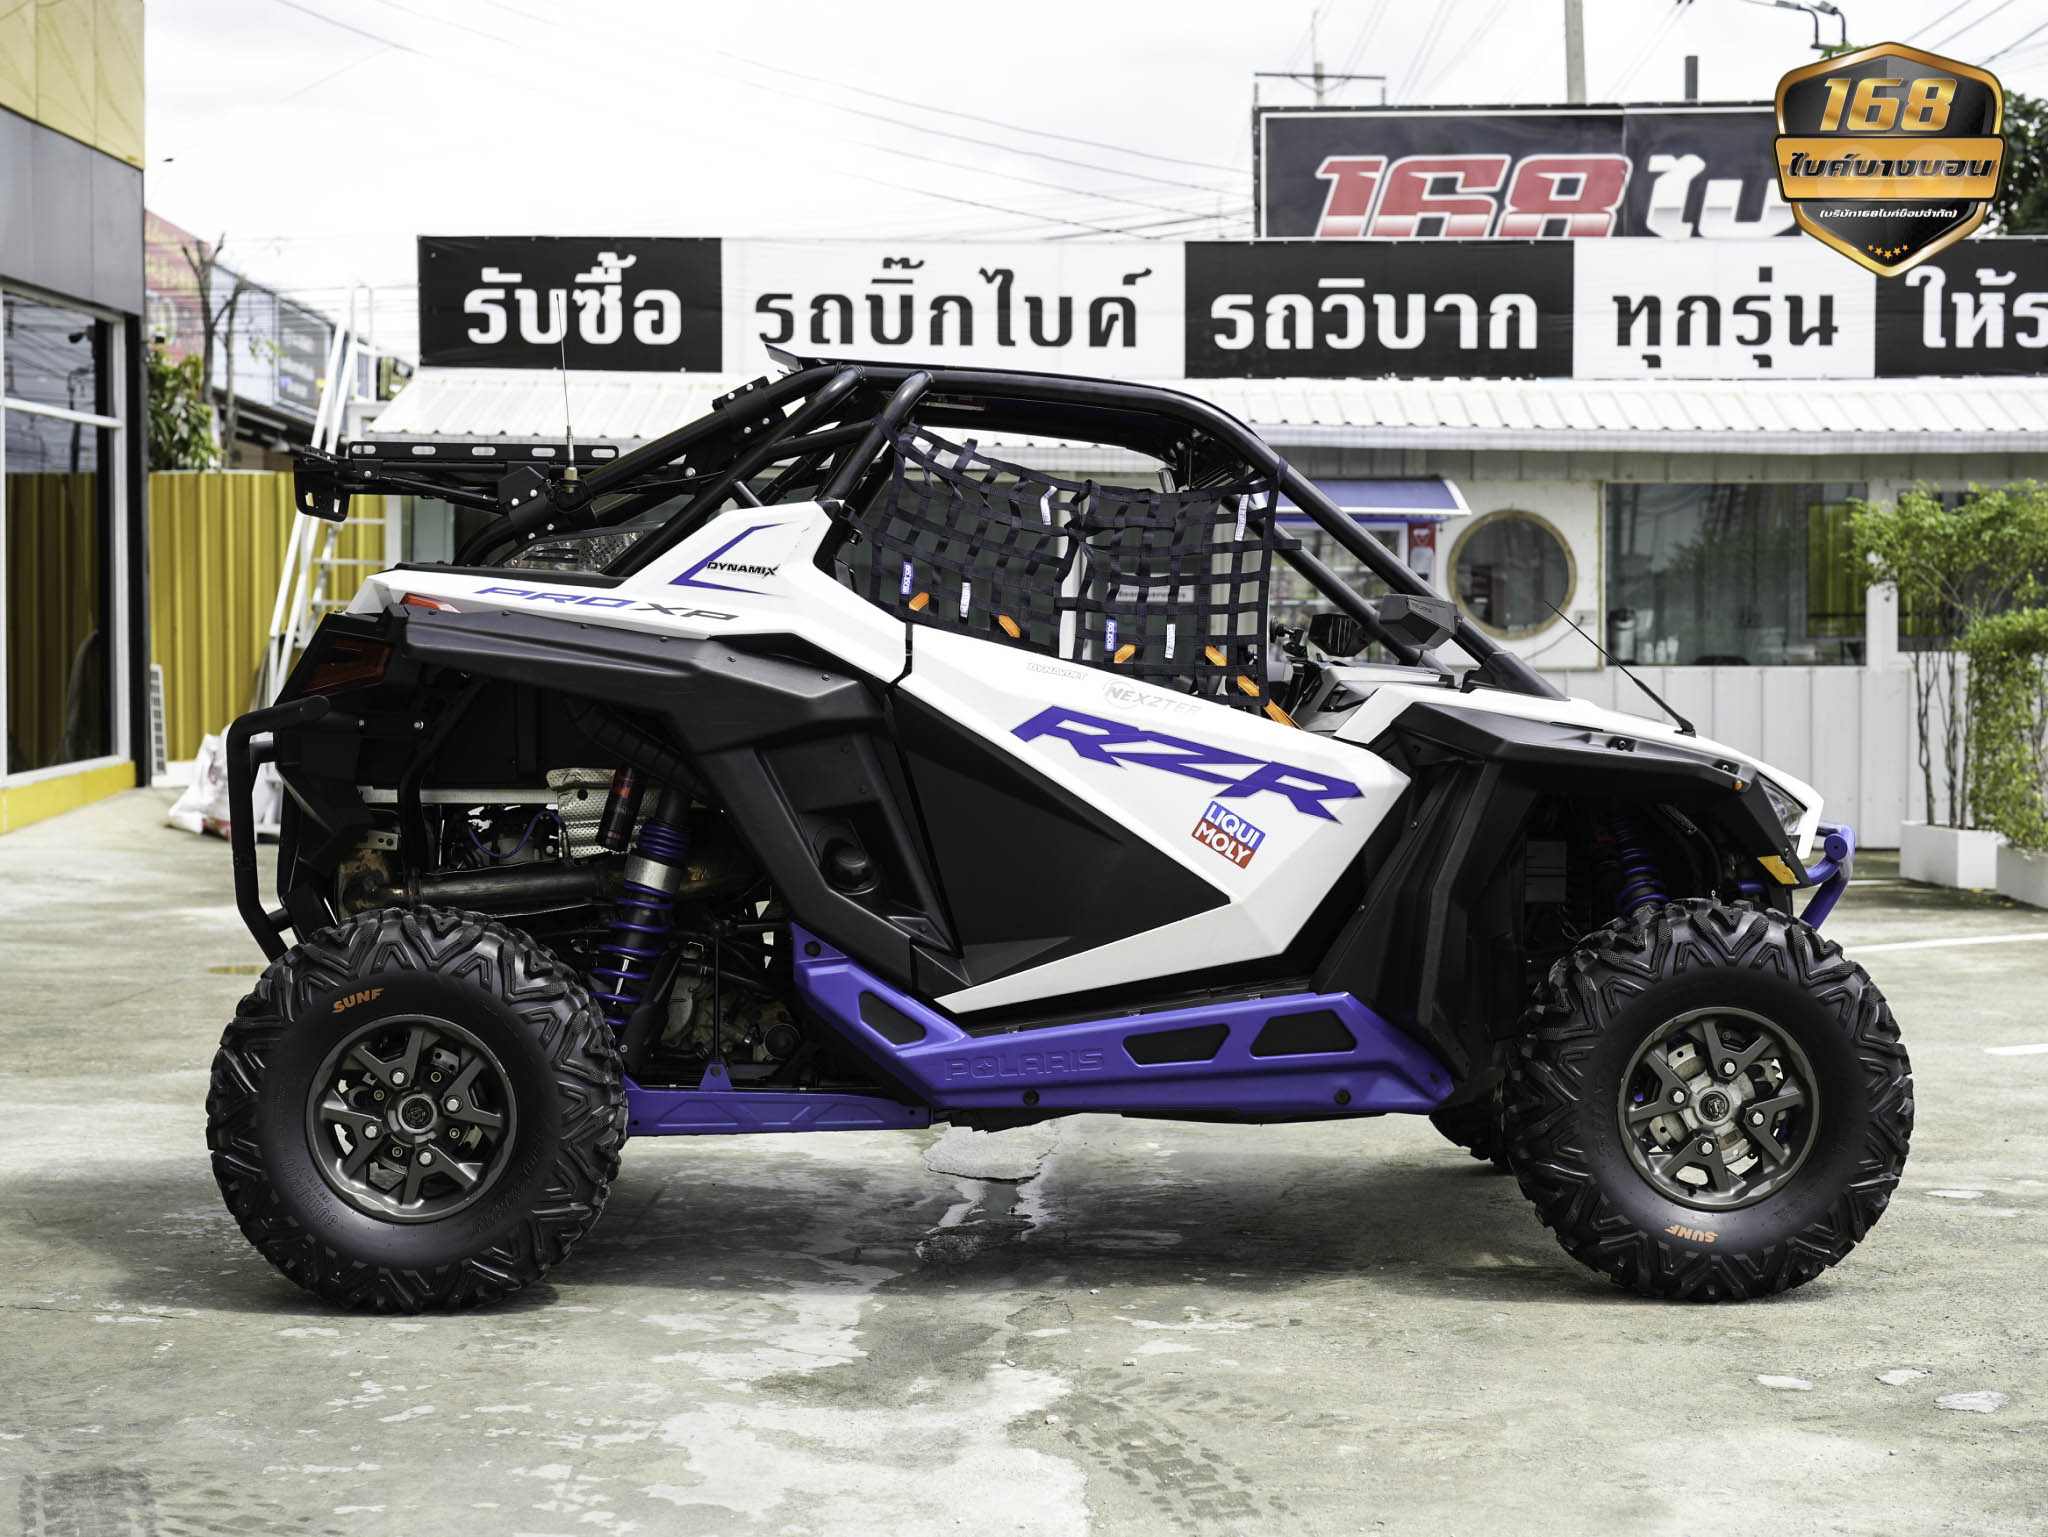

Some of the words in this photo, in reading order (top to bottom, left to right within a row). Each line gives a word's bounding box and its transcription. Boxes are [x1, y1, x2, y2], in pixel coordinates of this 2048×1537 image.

[1316, 153, 1633, 239] 168
[463, 251, 683, 346] รับซื้อ
[754, 256, 1153, 348] รถบิ๊กไบค์
[1210, 277, 1538, 350] รถวิบาก
[1612, 266, 1839, 369] ทุกรุ่น
[706, 562, 781, 579] DYNAMIX
[474, 585, 638, 609] PRO
[636, 602, 741, 621] XP
[1010, 706, 1366, 824] RZR
[1193, 821, 1252, 864] MOLY
[1204, 803, 1262, 849] LIQUI
[330, 987, 385, 1014] SUNF
[944, 1049, 1104, 1081] POLARIS
[1663, 1224, 1719, 1243] SUNF
